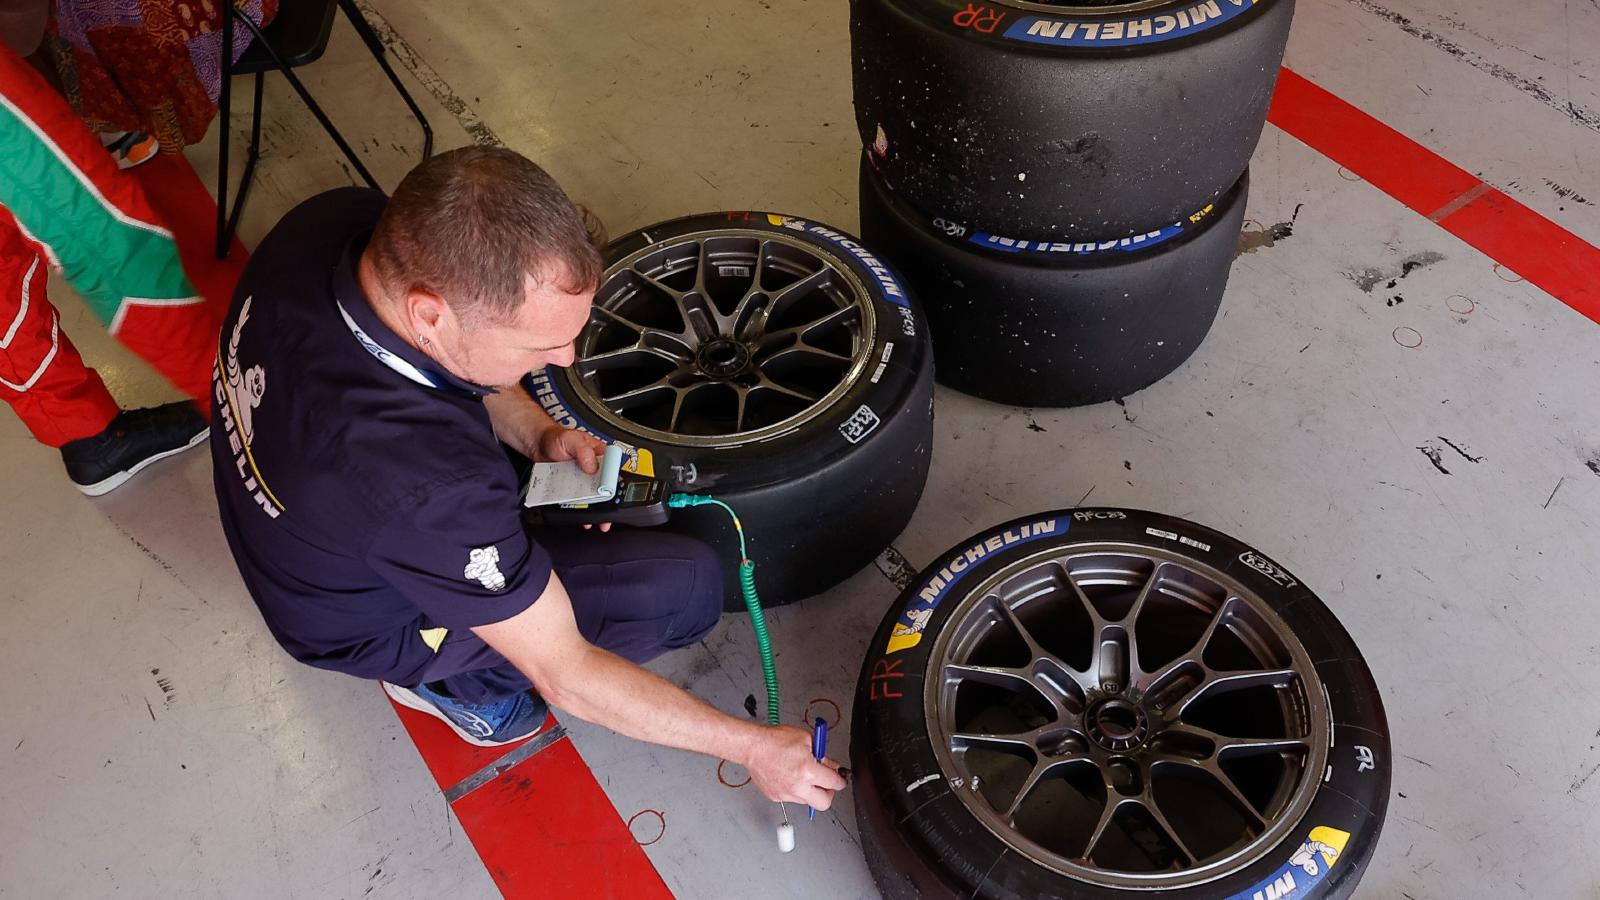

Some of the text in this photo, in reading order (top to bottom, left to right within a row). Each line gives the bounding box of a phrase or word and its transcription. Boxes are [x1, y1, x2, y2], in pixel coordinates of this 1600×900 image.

[953, 3, 1006, 33] RR
[1027, 0, 1222, 40] MICHELIN
[809, 227, 902, 298] MICHELIN
[212, 352, 280, 519] ICHELIN
[531, 369, 609, 446] CHELI
[920, 520, 1057, 603] MICHELIN
[870, 658, 904, 701] FR
